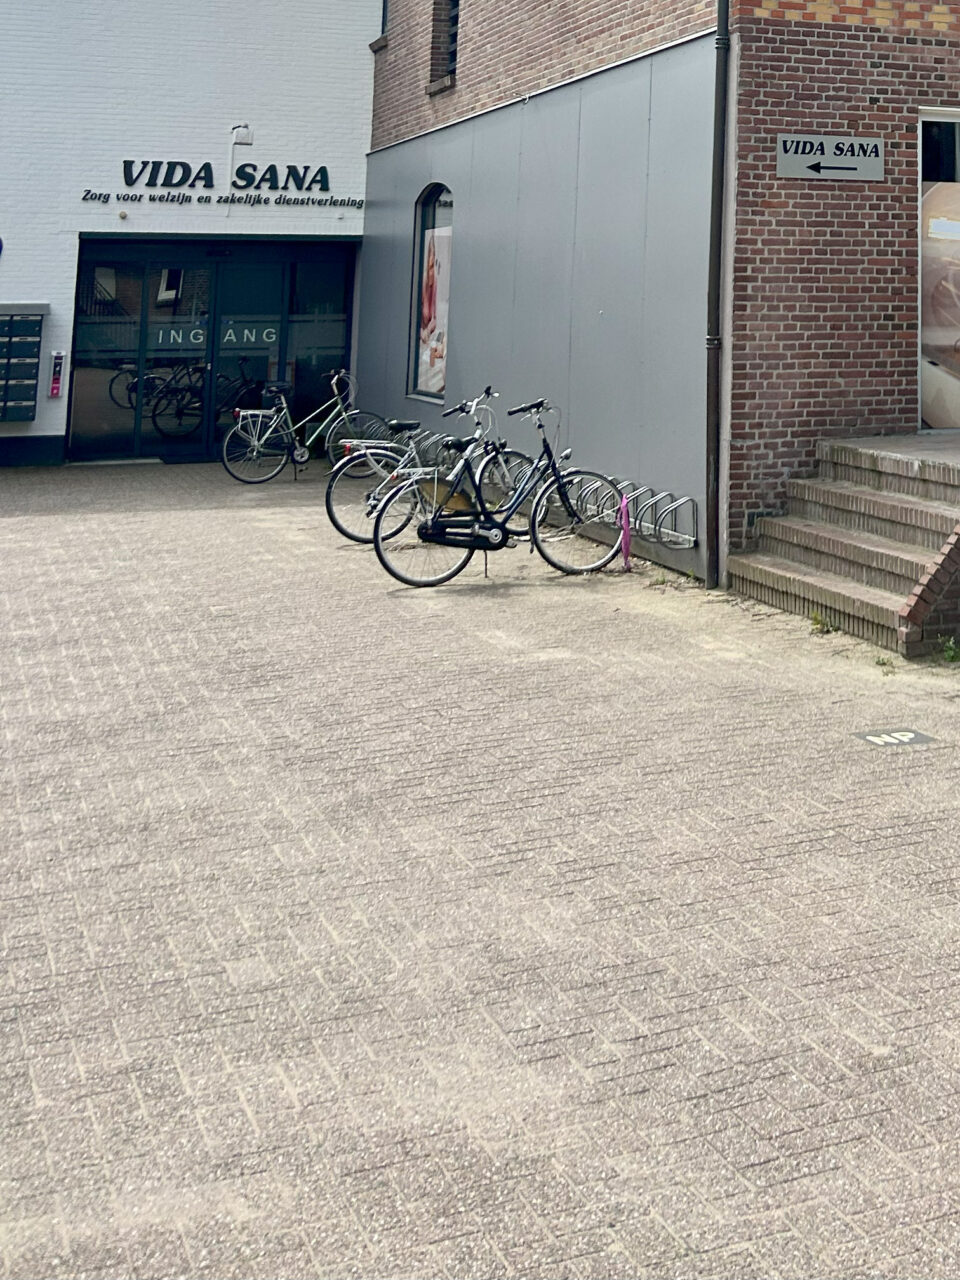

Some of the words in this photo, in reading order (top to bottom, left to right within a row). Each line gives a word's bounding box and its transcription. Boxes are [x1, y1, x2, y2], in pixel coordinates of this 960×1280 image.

[782, 140, 825, 156] VIDA
[833, 142, 880, 158] SANA
[122, 160, 215, 189] VIDA
[231, 163, 330, 192] SANA
[82, 189, 111, 204] Zorg
[116, 193, 144, 202] voor
[148, 191, 192, 205] welzijn
[197, 195, 212, 204] en
[216, 193, 270, 207] zakelijke
[274, 194, 364, 209] dienstverlening
[865, 731, 915, 746] NP
